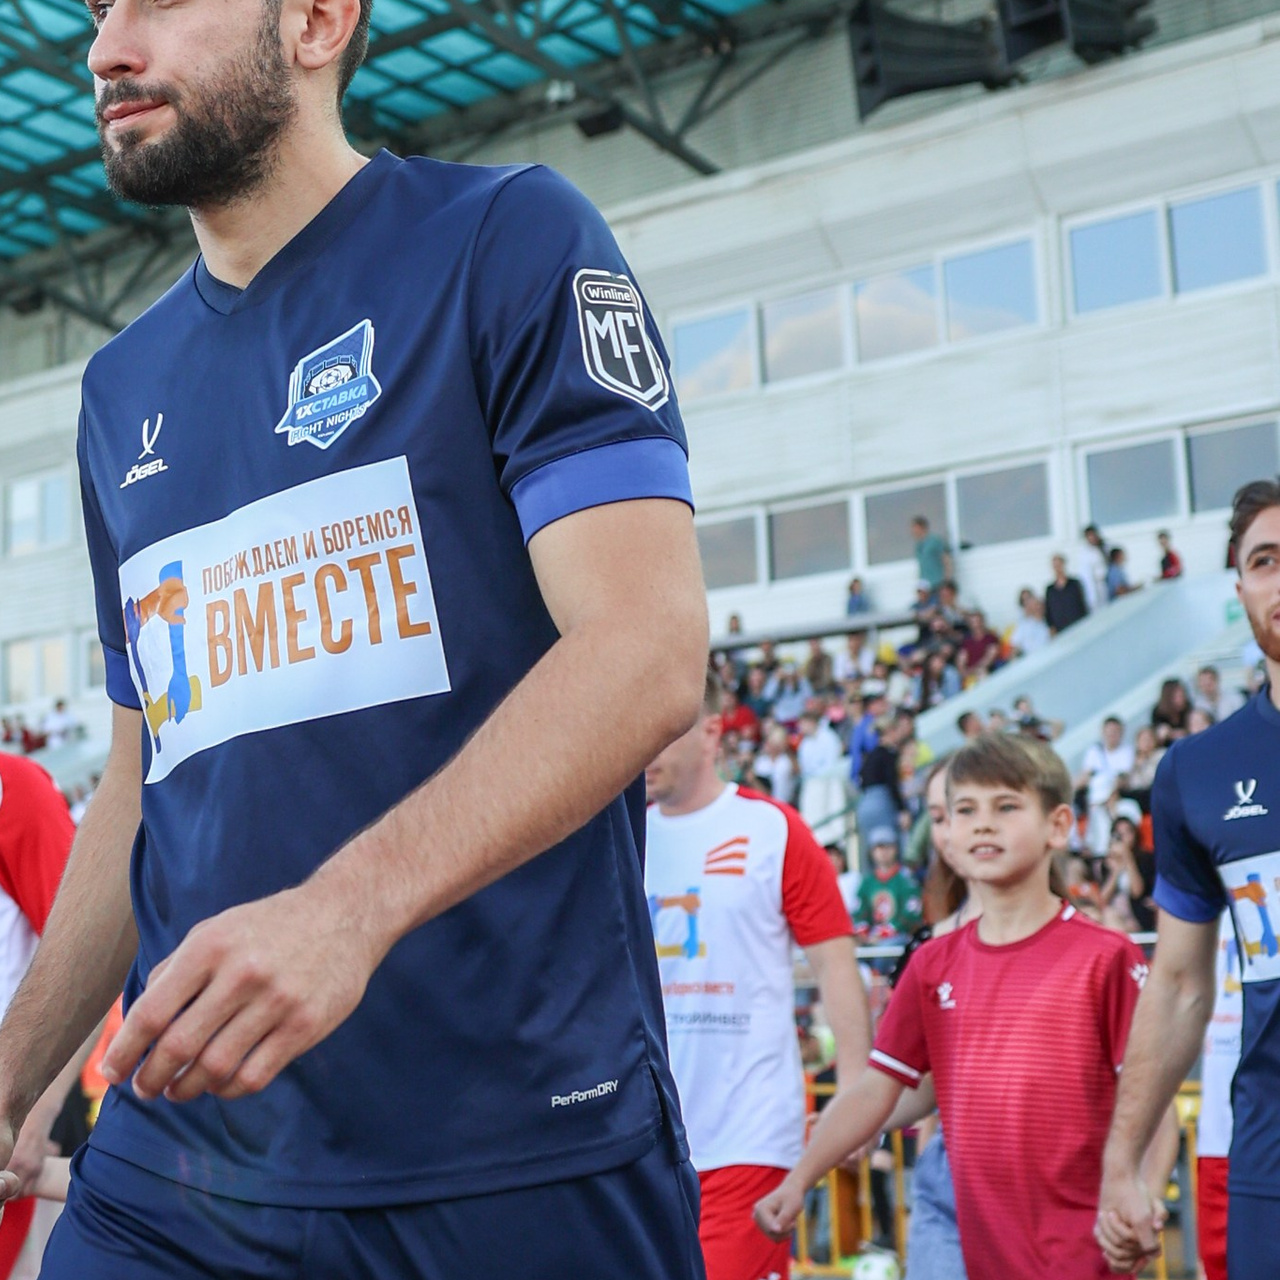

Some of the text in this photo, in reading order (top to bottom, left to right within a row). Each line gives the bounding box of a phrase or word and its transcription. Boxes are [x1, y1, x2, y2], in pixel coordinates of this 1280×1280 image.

[587, 286, 631, 301] Winline
[291, 421, 323, 442] FIGHT
[120, 459, 168, 489] JÖGEL
[202, 505, 413, 595] ПОБЕЖДАЕМ И БОРЕМСЯ
[206, 544, 431, 687] ВМЕСТЕ
